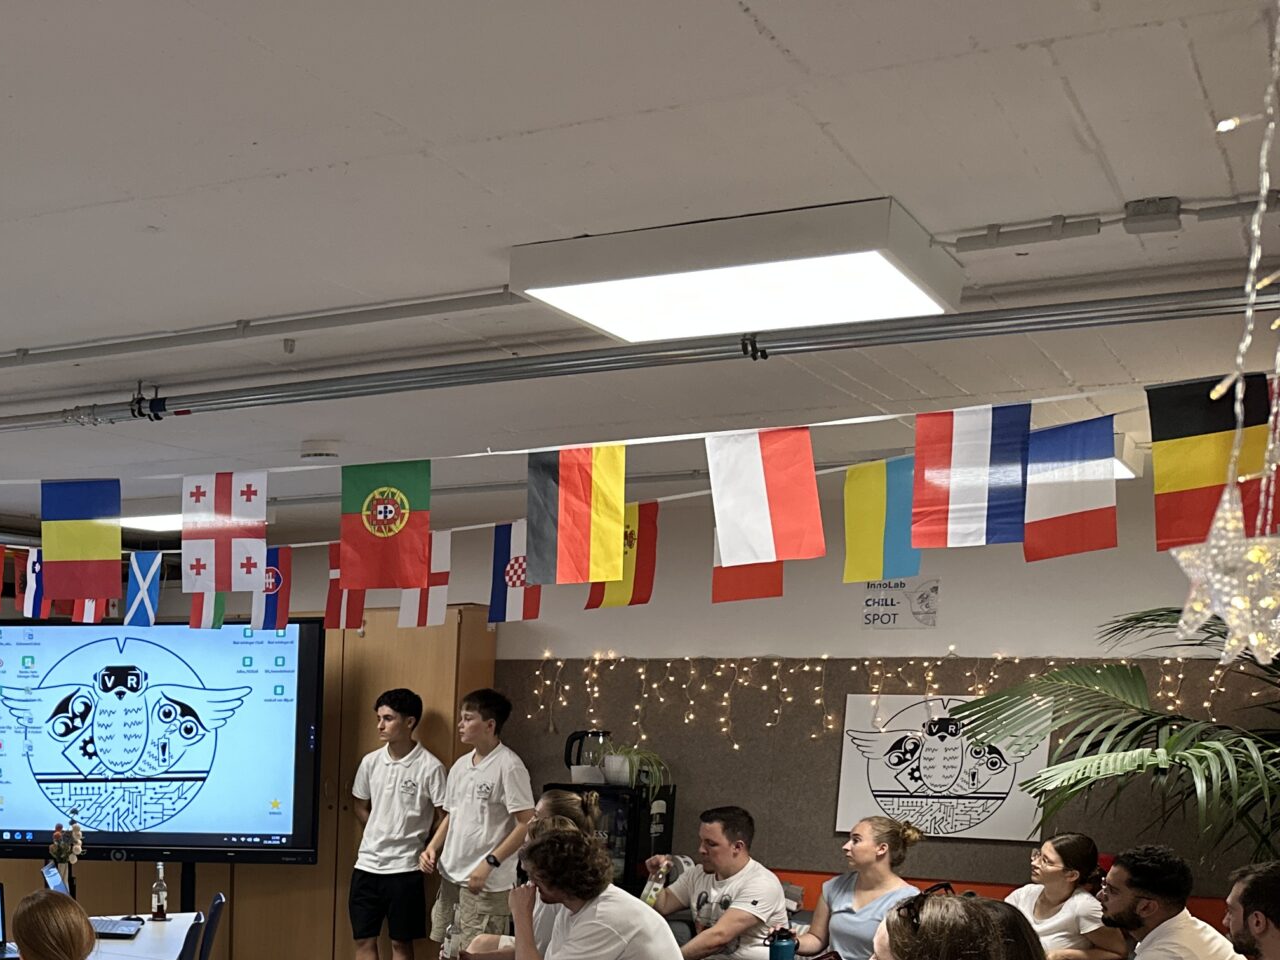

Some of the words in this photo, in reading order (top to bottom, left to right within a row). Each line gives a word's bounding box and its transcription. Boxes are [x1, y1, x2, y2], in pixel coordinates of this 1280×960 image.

[866, 581, 906, 589] InnoLab
[865, 598, 901, 607] CHILL-
[864, 613, 899, 625] SPOT
